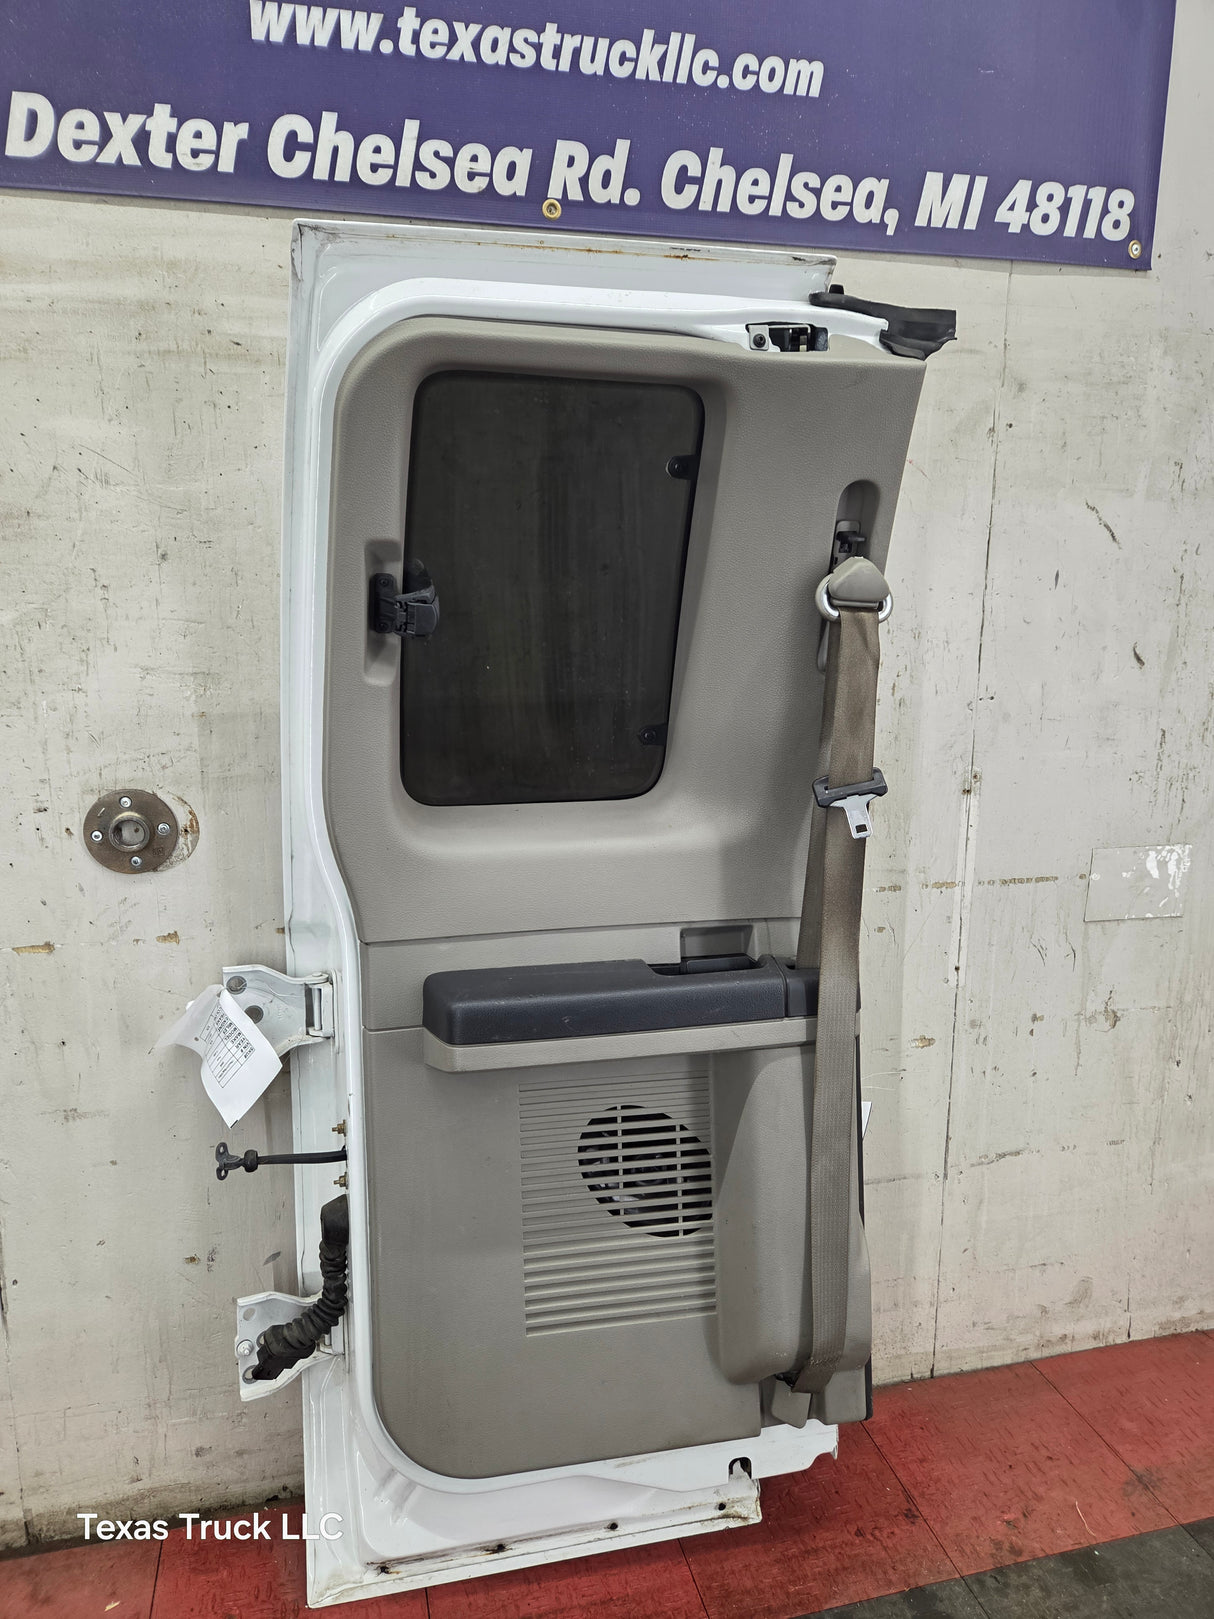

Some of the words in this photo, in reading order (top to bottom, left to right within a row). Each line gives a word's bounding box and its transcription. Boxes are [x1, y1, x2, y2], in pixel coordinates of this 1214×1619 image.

[250, 0, 824, 98] www.texastruckllc.com
[5, 91, 250, 173] Dexter
[268, 111, 534, 197] Chelsea
[547, 139, 641, 206] Rd.
[661, 147, 900, 236] Chelsea,
[914, 171, 988, 230] MI
[994, 179, 1134, 241] 48118
